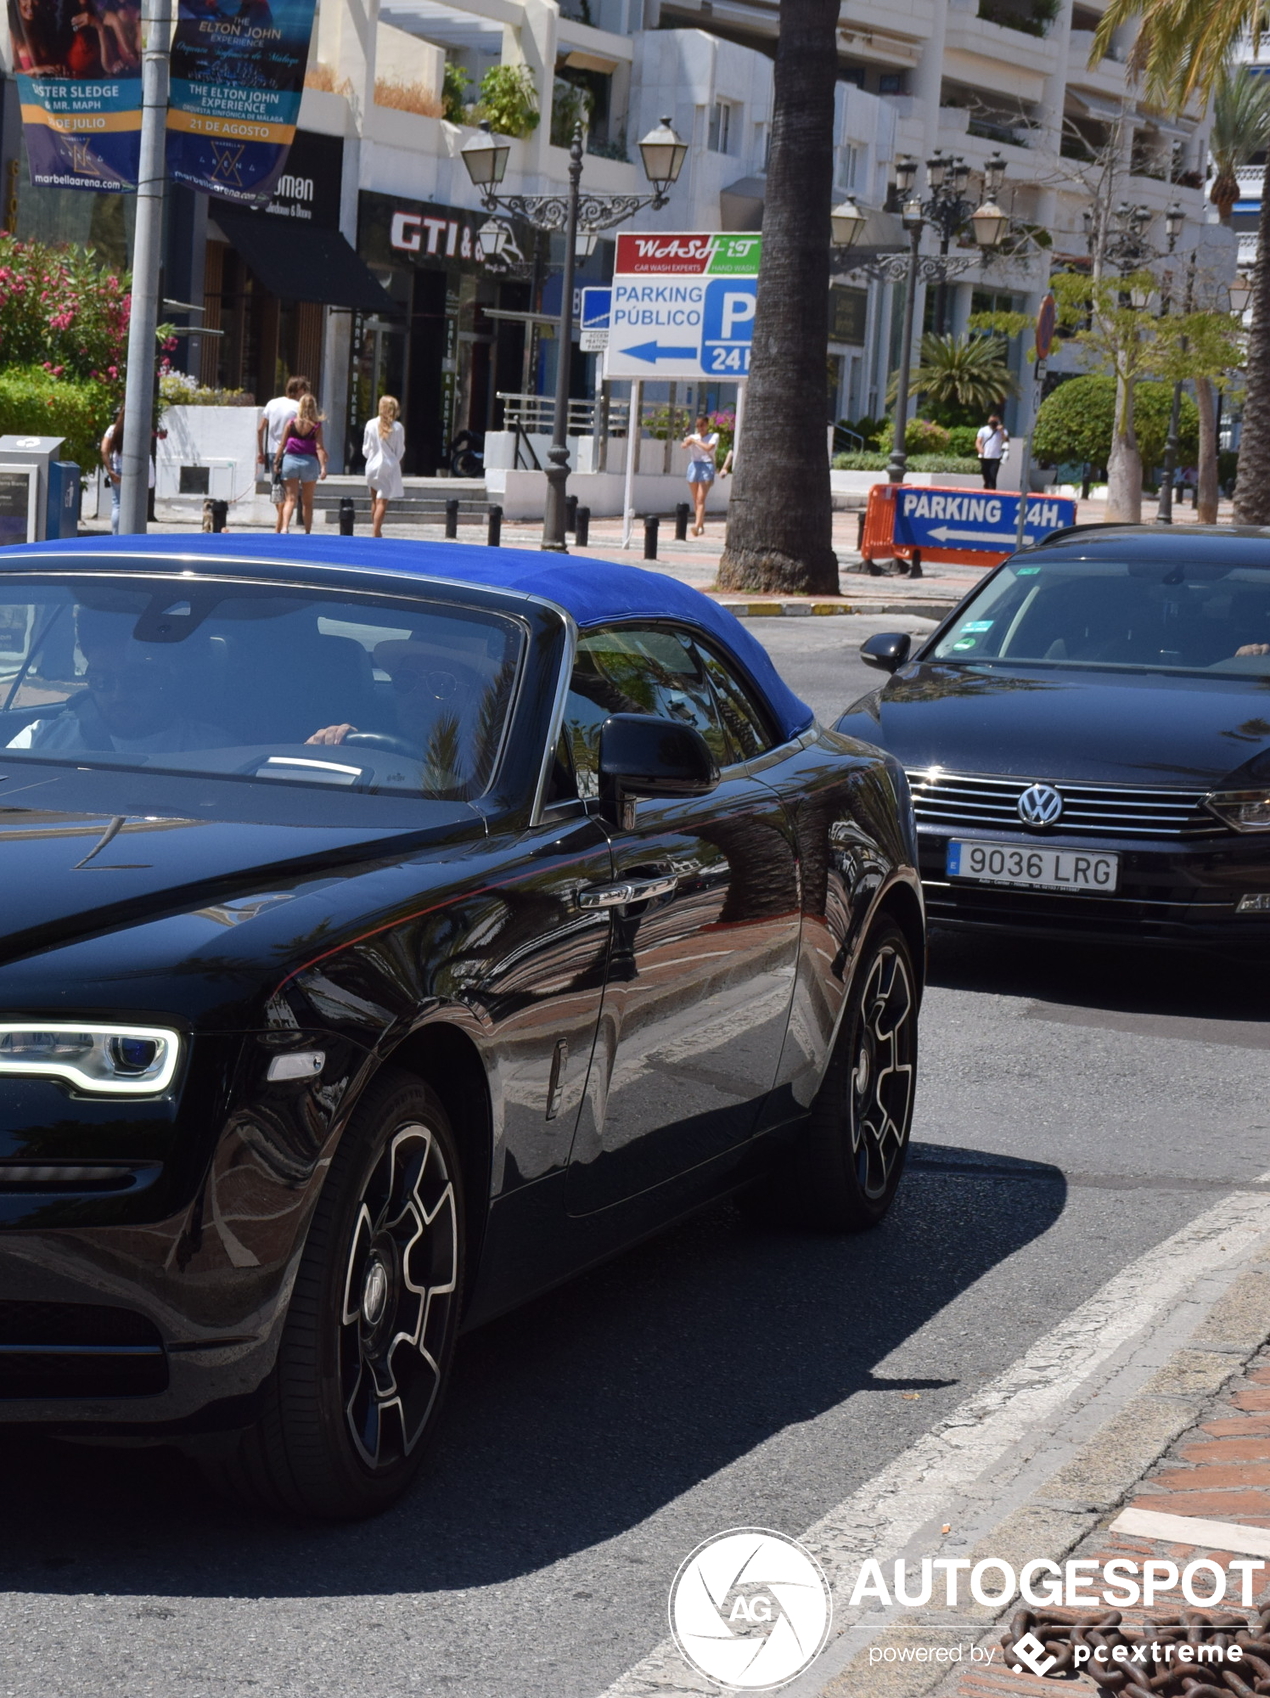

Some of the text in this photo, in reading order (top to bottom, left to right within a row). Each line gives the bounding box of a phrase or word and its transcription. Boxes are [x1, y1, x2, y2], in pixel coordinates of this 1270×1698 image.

[233, 17, 250, 26] THE
[199, 21, 282, 39] ELTON JOHN
[210, 34, 265, 48] EXPERIENCE
[70, 86, 120, 98] SLEDGE
[189, 84, 279, 104] THE ELTON JOHN
[53, 101, 71, 110] MR.
[72, 101, 102, 110] MAPH
[182, 104, 211, 115] ORQUESTA
[201, 97, 267, 113] EXPERIENCE
[72, 118, 106, 129] JULIO
[190, 119, 269, 137] 21 DE AGOSTO
[35, 175, 121, 190] marbellaarena.com
[391, 210, 459, 257] GTI
[634, 264, 701, 272] CAR WASH EXPERTS
[711, 264, 756, 272] HAND WASH
[615, 286, 703, 303] PARKING
[614, 306, 701, 326] PÚBLICO
[721, 292, 757, 339] P
[903, 493, 1002, 524] PARKING
[970, 848, 1111, 885] 9036 LRG
